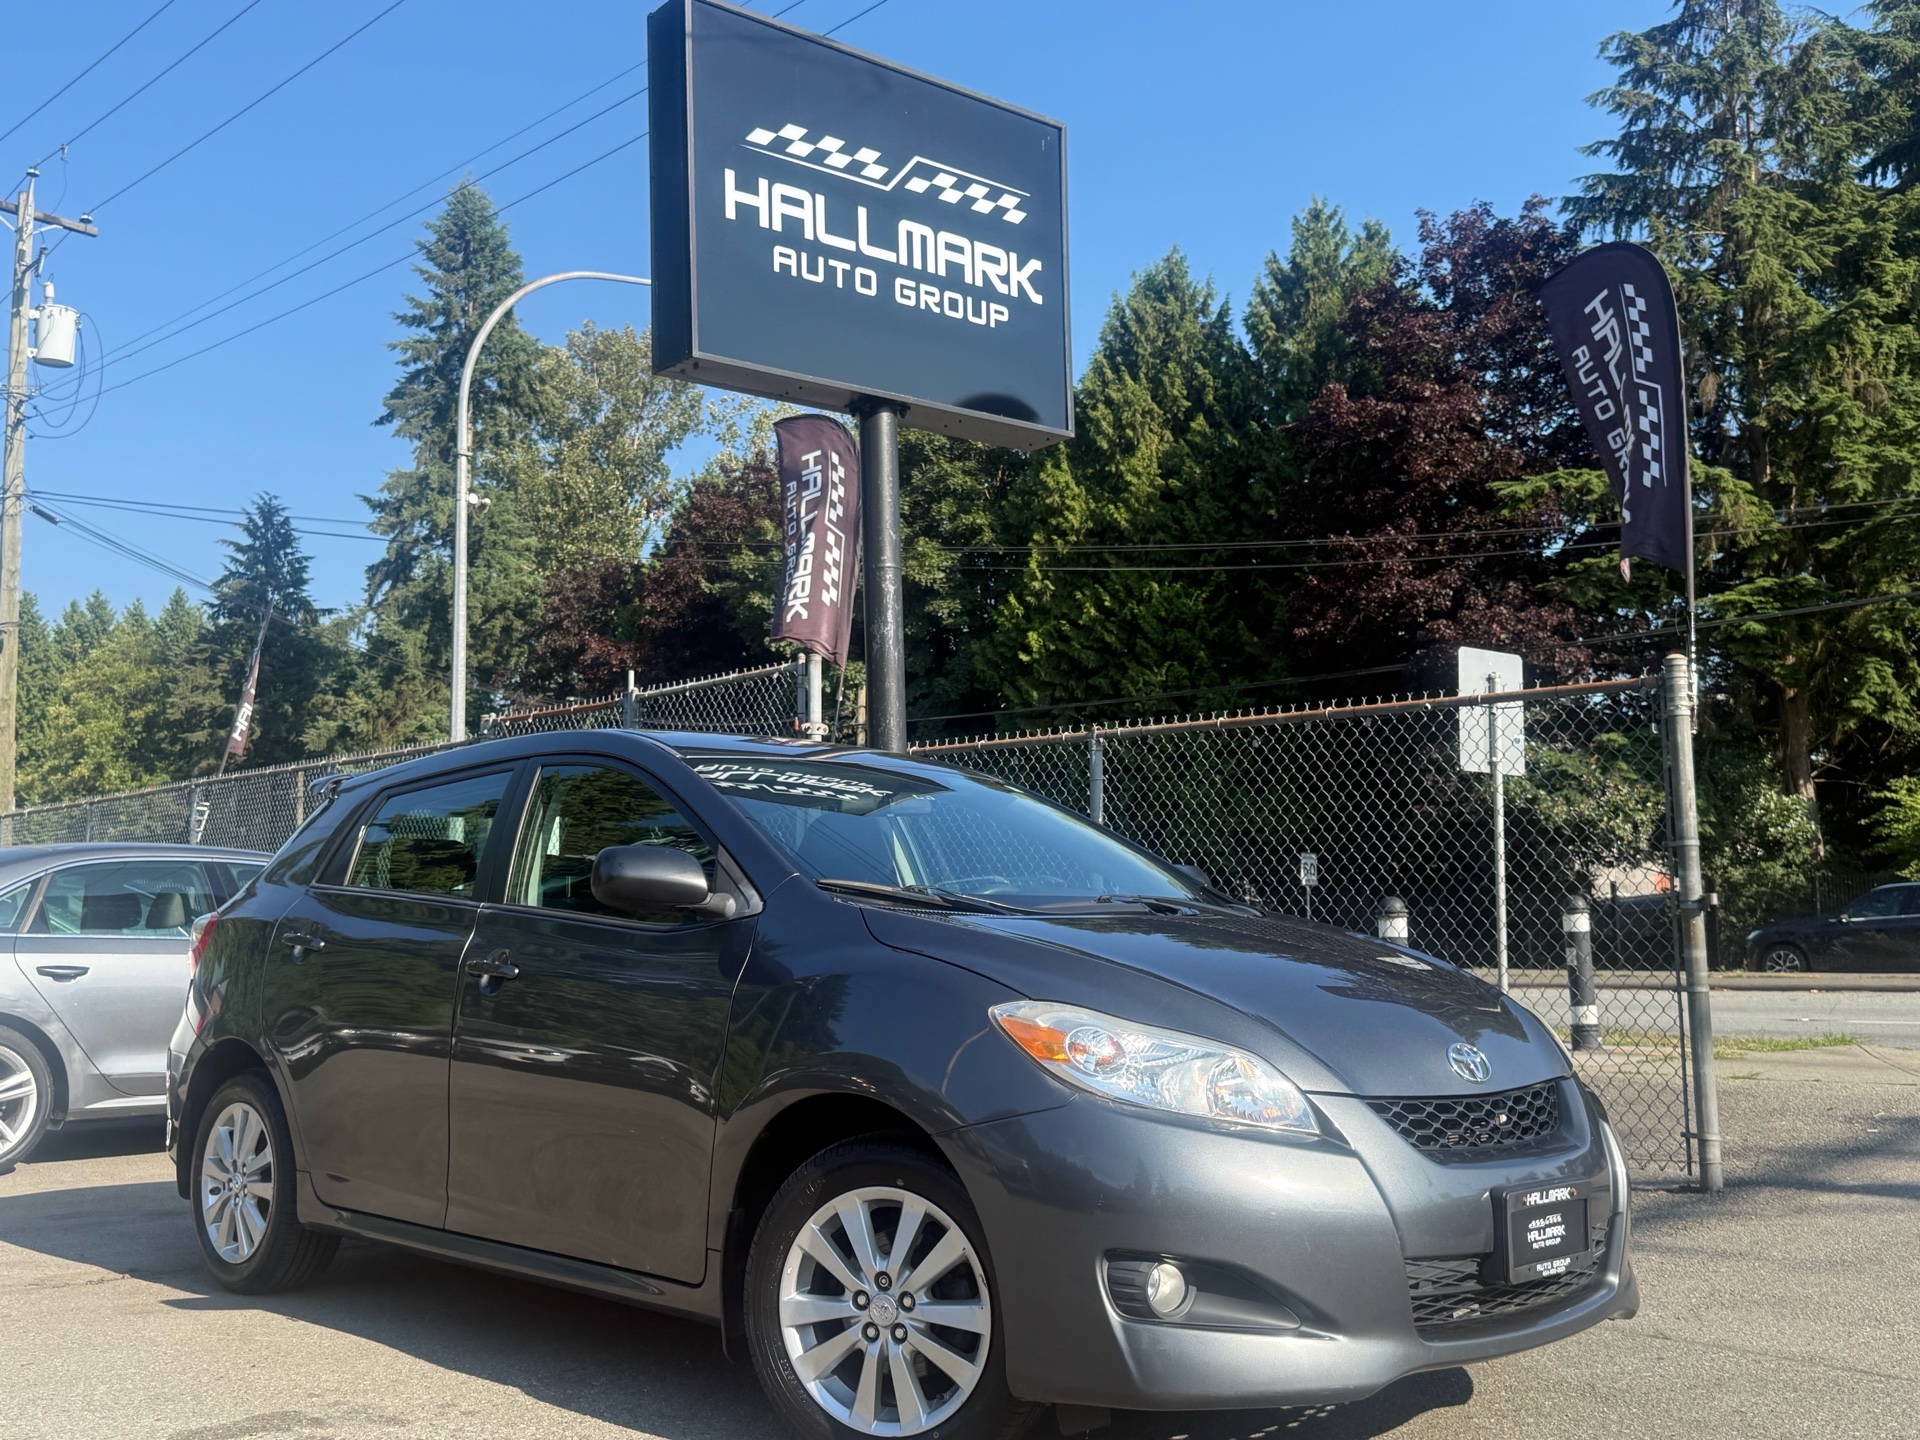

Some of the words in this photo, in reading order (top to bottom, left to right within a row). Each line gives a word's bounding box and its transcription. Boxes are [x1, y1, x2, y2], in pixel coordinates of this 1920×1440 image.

[724, 168, 1043, 305] HALLMARK
[773, 245, 877, 297] AUTO
[894, 277, 1009, 328] GROUP
[1571, 345, 1615, 421] AUTO
[786, 481, 798, 536] AUTO
[786, 450, 822, 623] HALLMARK
[1303, 862, 1316, 876] 60
[1526, 1187, 1570, 1206] HALLMARK
[1527, 1225, 1566, 1242] HALLMARK
[1536, 1262, 1551, 1271] AUTO
